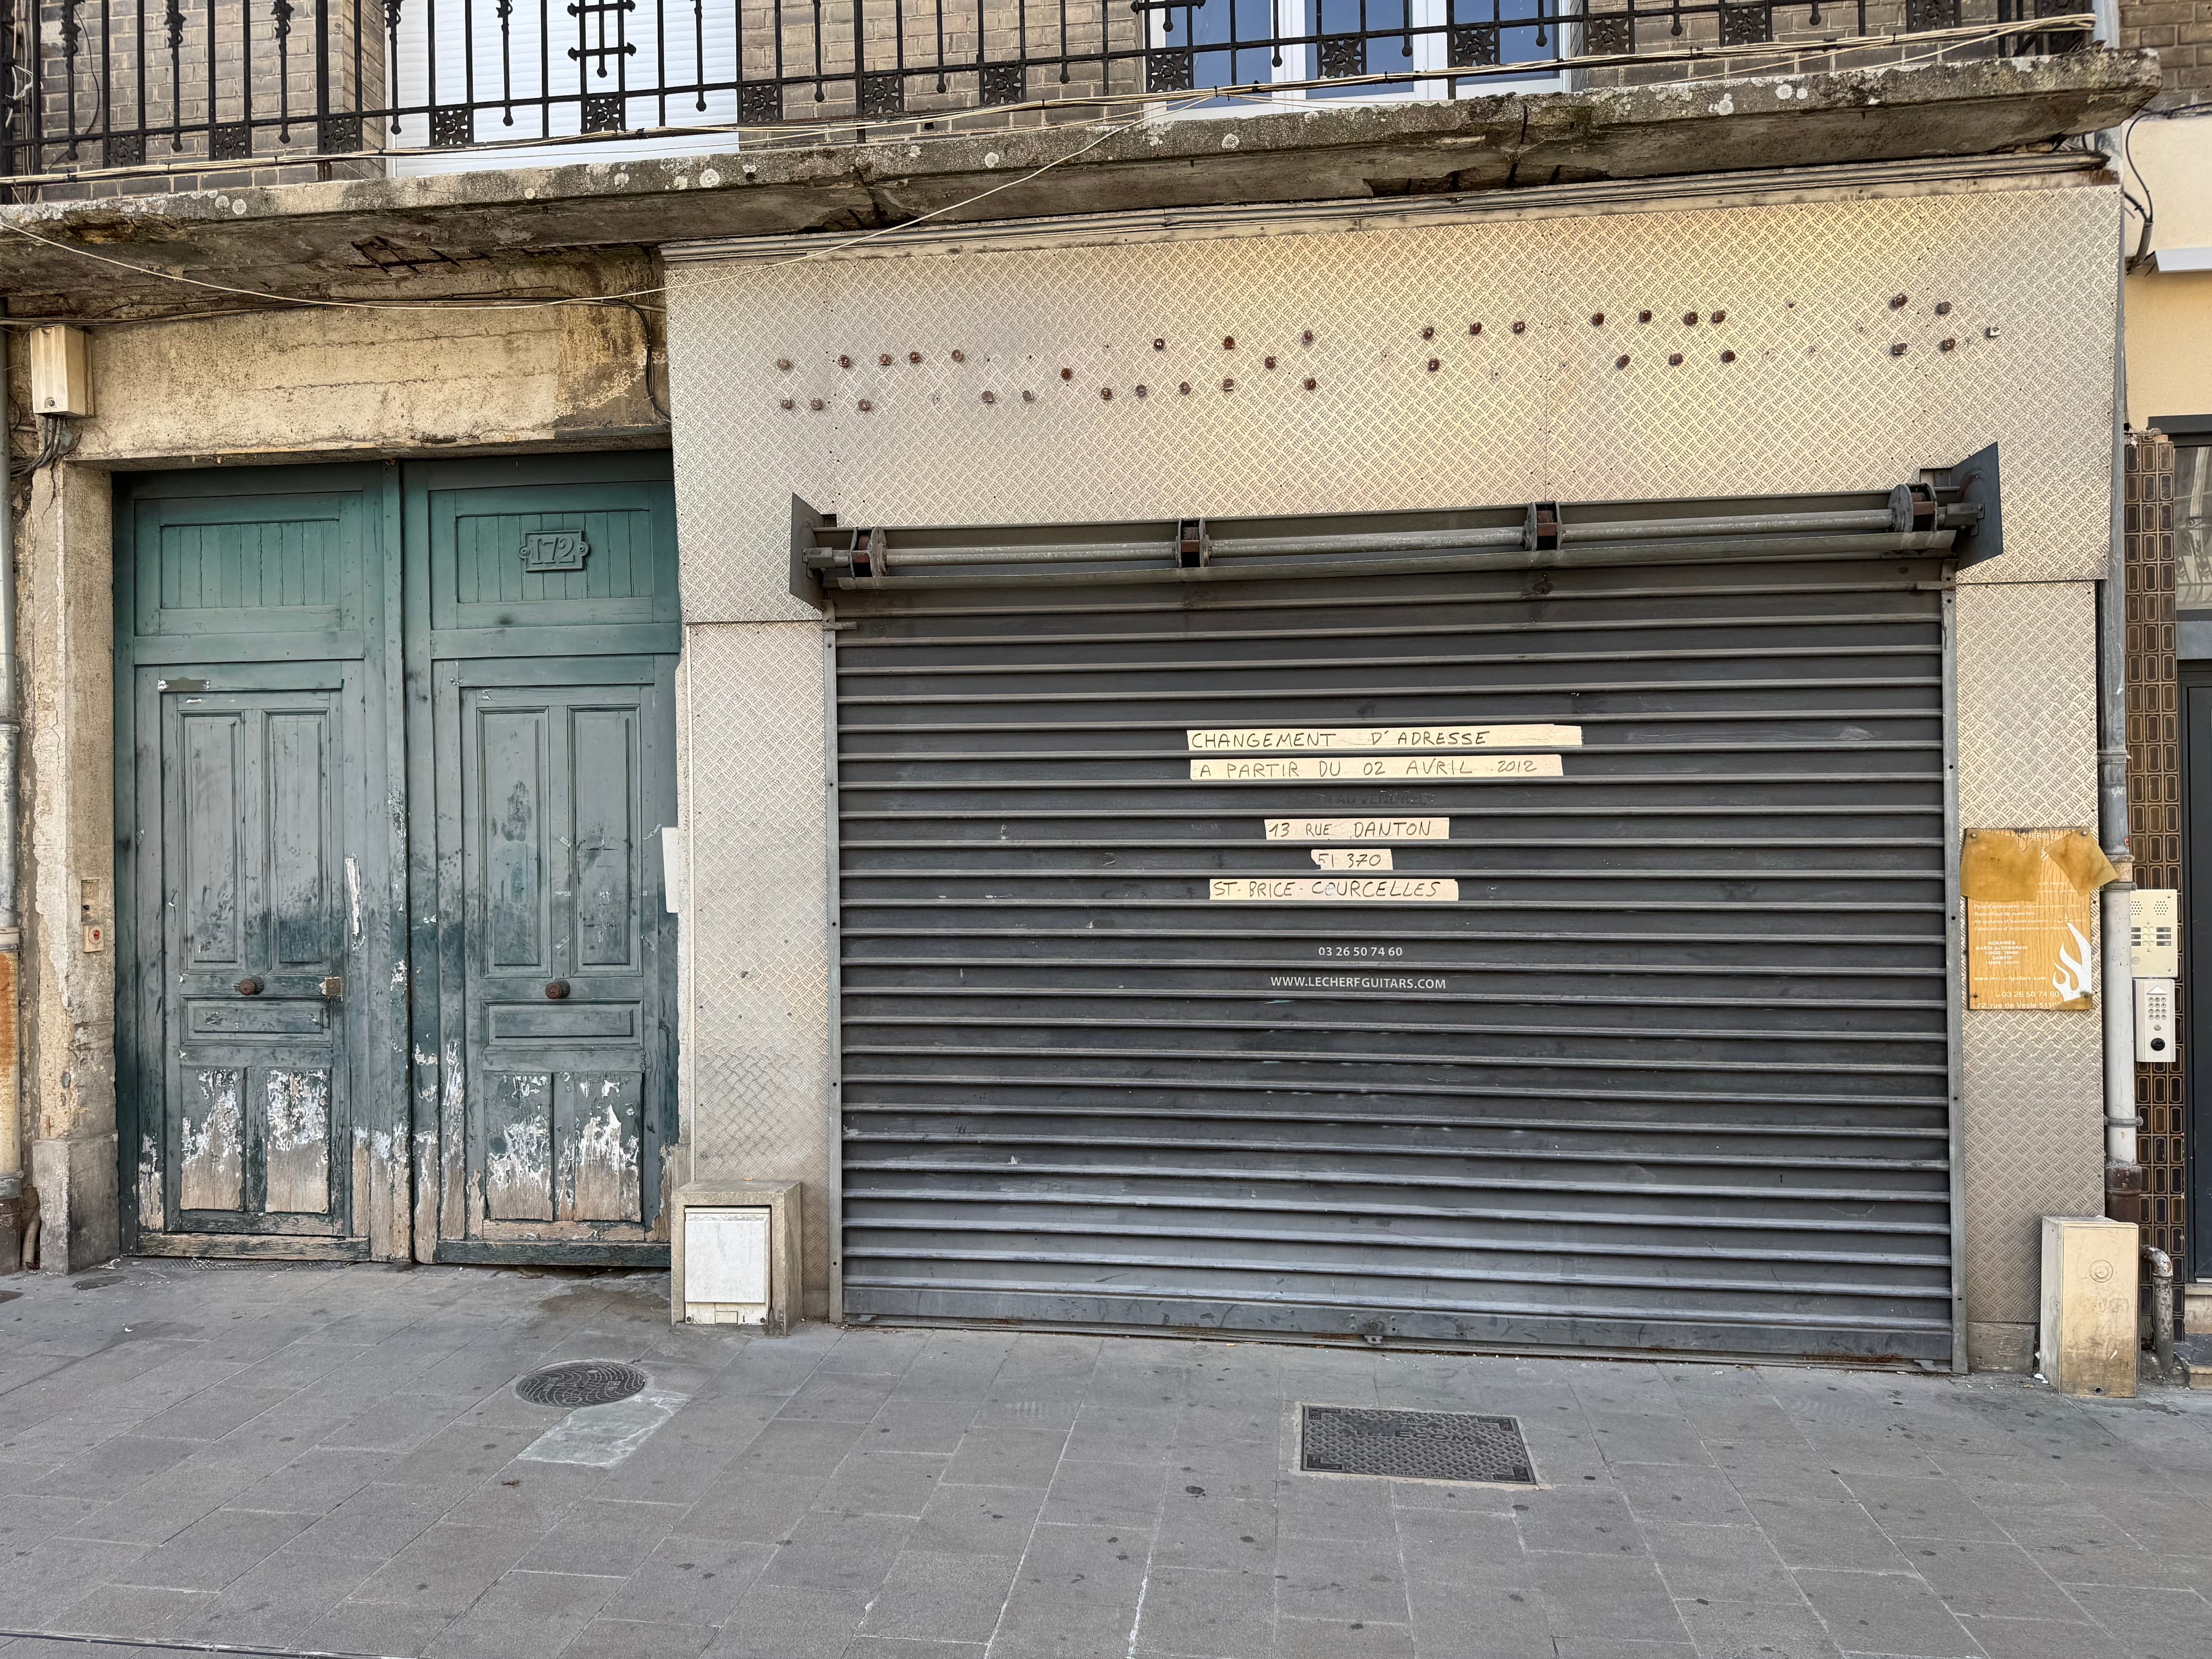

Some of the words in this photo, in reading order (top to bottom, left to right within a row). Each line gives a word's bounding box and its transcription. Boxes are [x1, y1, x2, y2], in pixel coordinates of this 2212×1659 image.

[530, 536, 575, 565] 172
[1191, 732, 1336, 748] CHANGEMENT
[1200, 764, 1211, 777] A
[1227, 762, 1300, 778] PARTIR
[1319, 760, 1341, 777] DU
[1363, 761, 1385, 775] 02
[1406, 757, 1472, 775] AVRIL
[1497, 760, 1537, 772] 2012
[1268, 822, 1290, 838] 13
[1305, 823, 1332, 837] RUE
[1354, 820, 1431, 838] DANTON
[1317, 853, 1334, 868] 51
[1347, 853, 1381, 868] 370
[1319, 946, 1333, 956] 03
[1336, 946, 1350, 956] 26
[1353, 946, 1368, 956] 50
[1370, 946, 1385, 956] 74
[1388, 946, 1403, 956] 60
[1270, 976, 1446, 989] WWW.LECHERFGUITARS.COM
[1354, 1430, 1474, 1442] ELECOM
